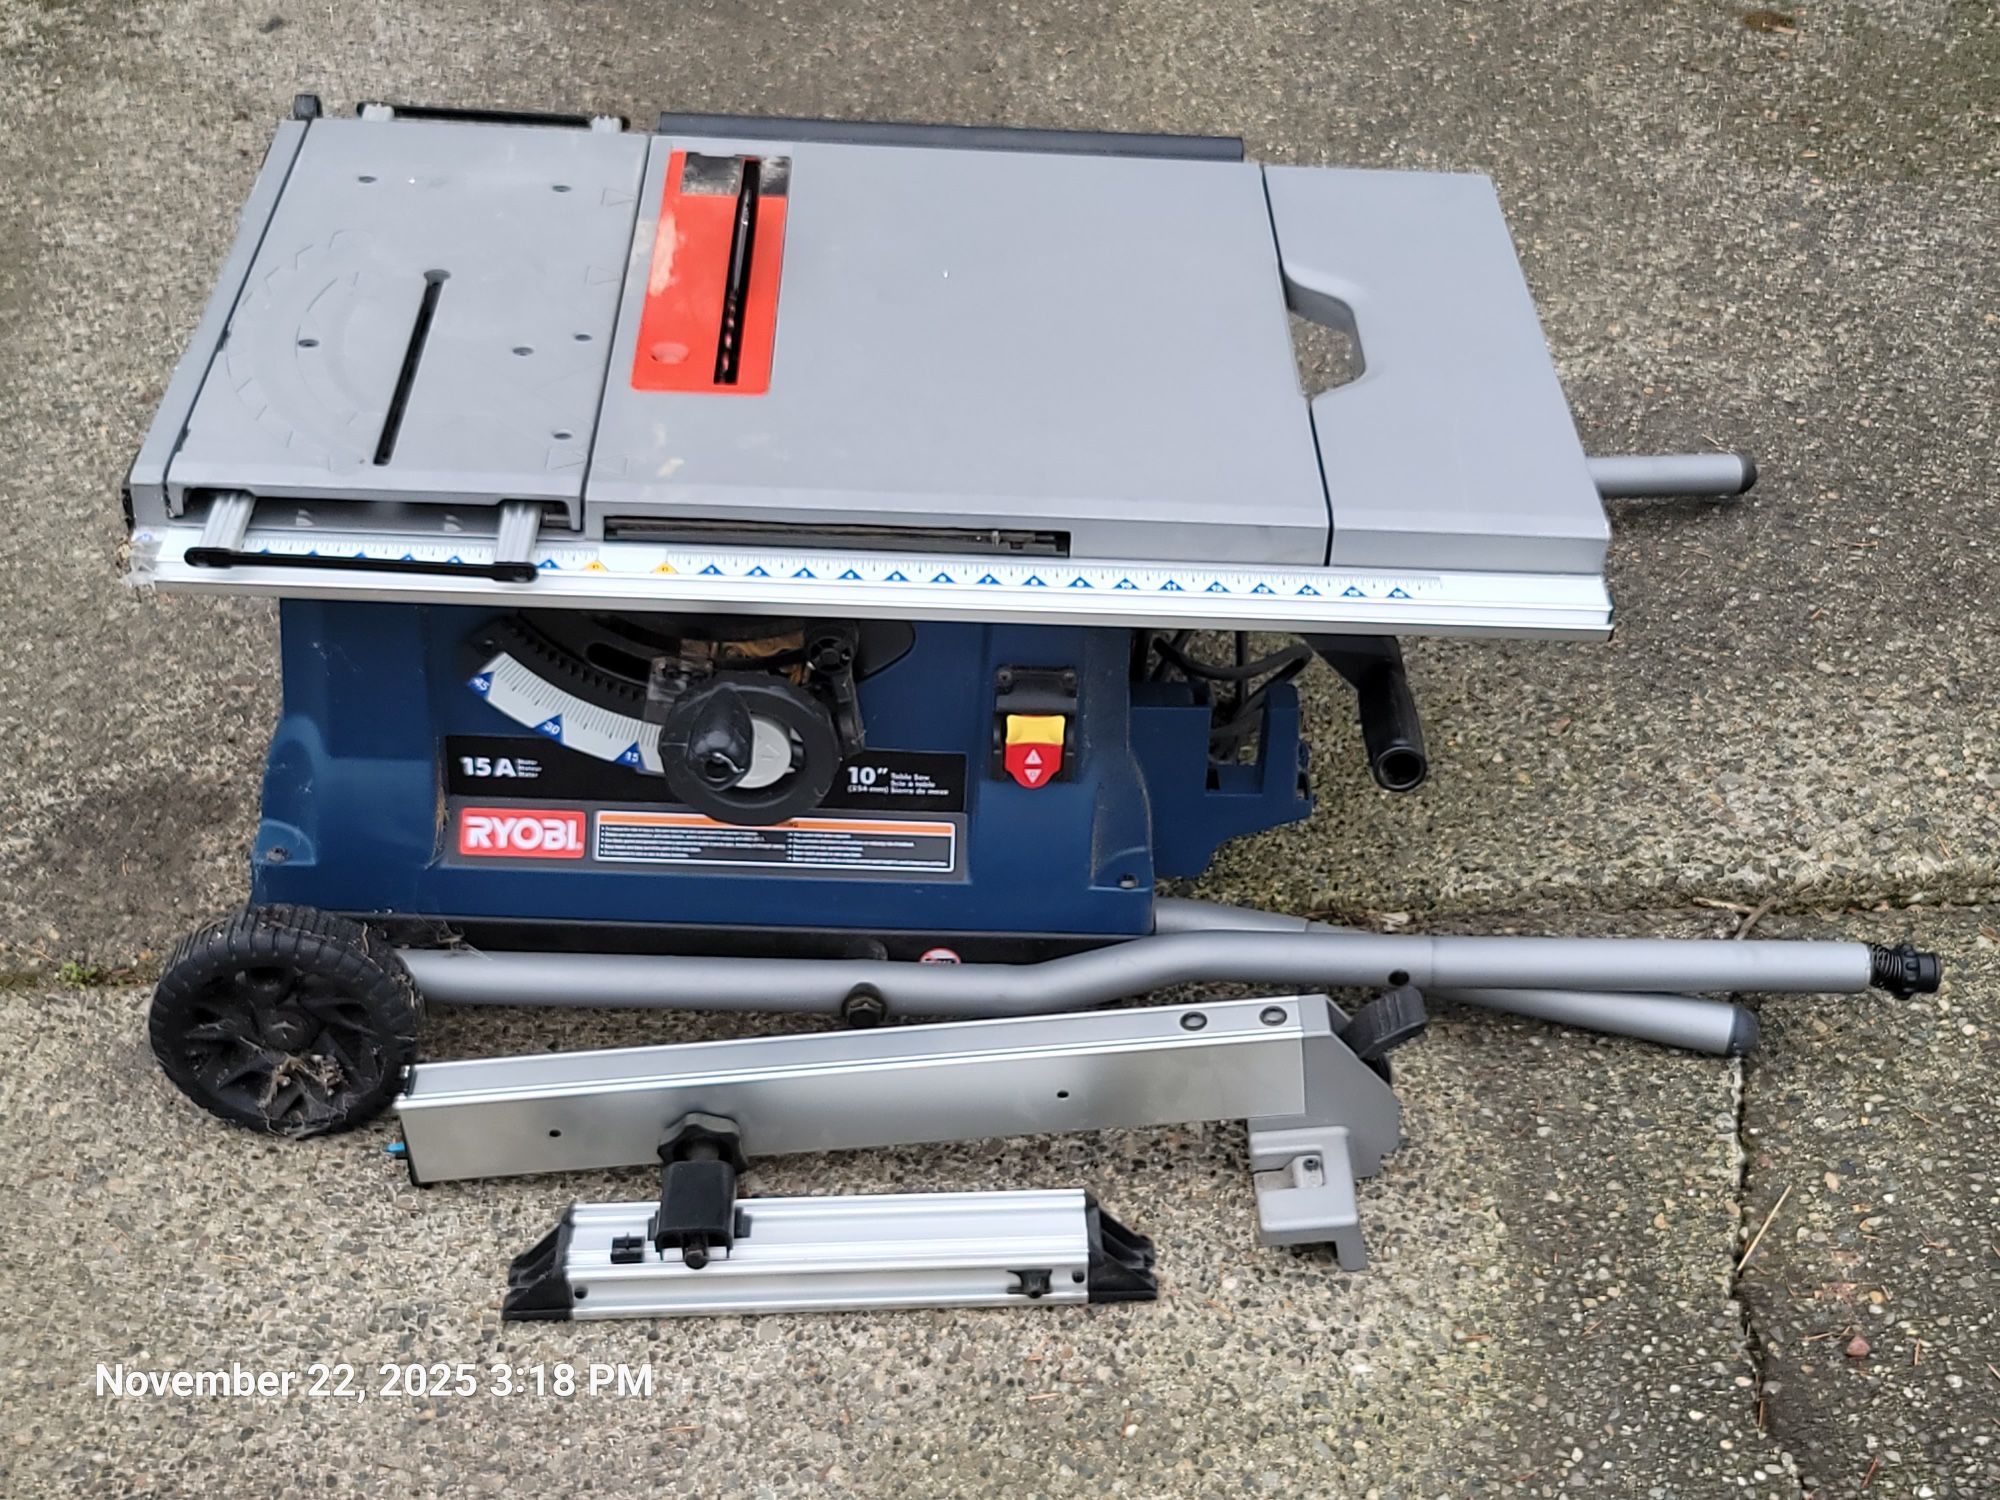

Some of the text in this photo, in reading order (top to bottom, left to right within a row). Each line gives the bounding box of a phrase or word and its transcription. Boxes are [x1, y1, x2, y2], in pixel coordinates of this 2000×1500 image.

[544, 721, 560, 735] 30
[624, 751, 640, 764] 15
[465, 817, 579, 850] RYOBI
